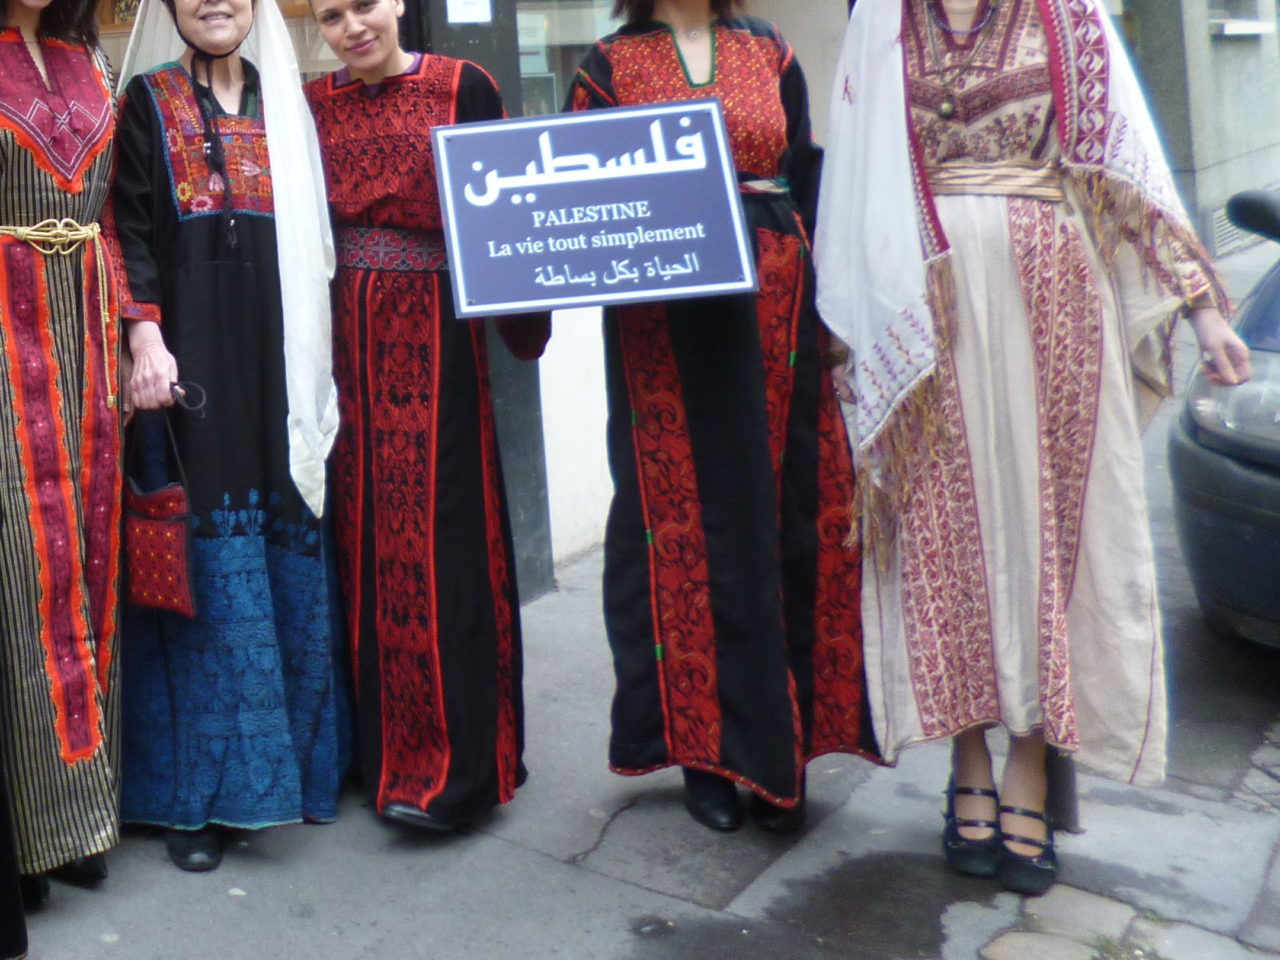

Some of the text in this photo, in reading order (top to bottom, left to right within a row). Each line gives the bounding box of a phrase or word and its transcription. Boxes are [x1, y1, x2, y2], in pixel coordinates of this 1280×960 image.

[463, 116, 708, 207] فلسطين
[531, 200, 652, 229] PALESTINE
[487, 222, 706, 259] La vie tout simplement
[534, 251, 700, 288] الحياة بكل بساطة
